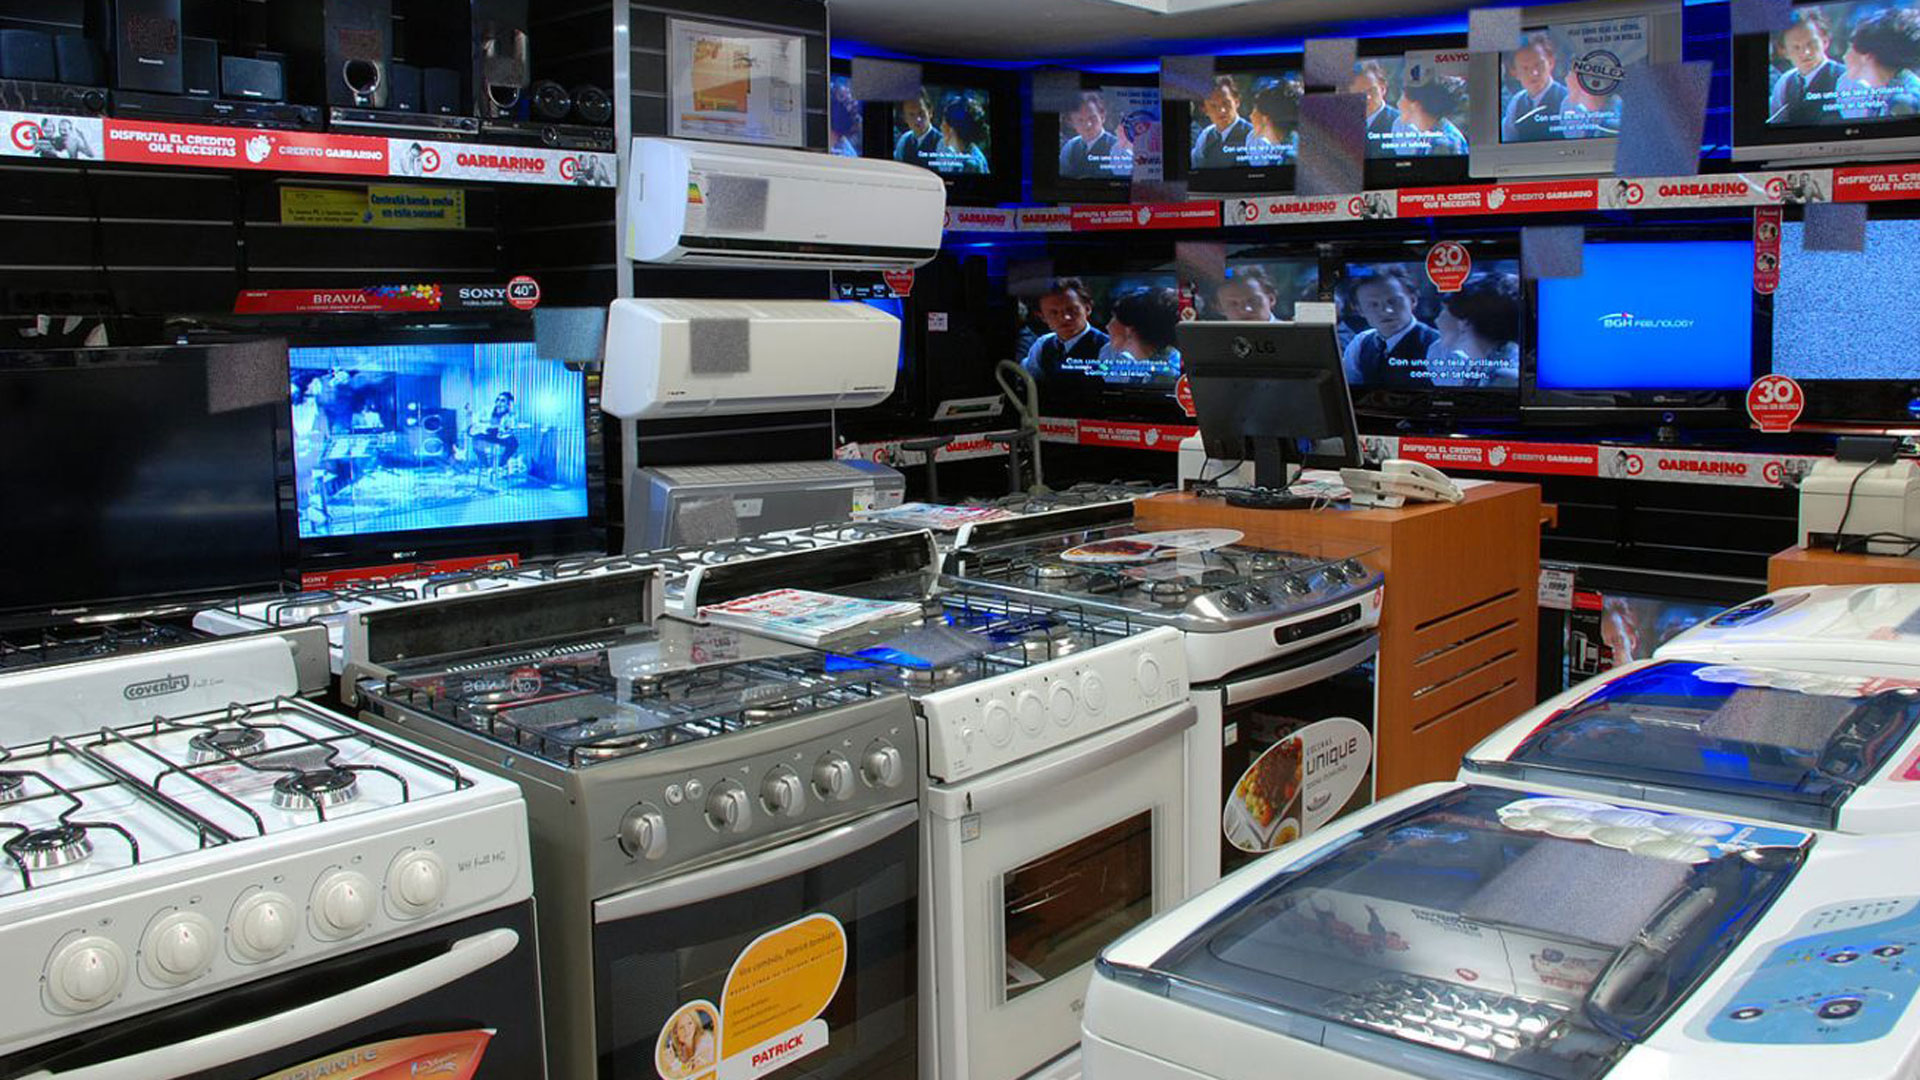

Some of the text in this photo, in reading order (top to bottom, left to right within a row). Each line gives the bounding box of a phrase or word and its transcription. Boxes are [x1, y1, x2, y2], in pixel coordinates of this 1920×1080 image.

[1434, 53, 1470, 63] SANYO
[1574, 61, 1626, 77] NOBLEX
[1806, 92, 1821, 100] Con
[1533, 113, 1548, 122] Con
[110, 129, 236, 147] DISFRUTA EL CREDITO
[148, 142, 236, 158] QUE NECESITAS
[278, 145, 383, 161] CREDITO GARBARINO
[457, 153, 545, 171] GARBARINO
[1838, 174, 1885, 185] DISFRUTA
[1888, 173, 1900, 182] EL
[1659, 181, 1748, 197] GARBARINO
[1869, 182, 1891, 191] QUE
[1400, 192, 1481, 203] DISFRUTA EL CREDITO
[1511, 190, 1593, 202] CREDITO GARBARINO
[1269, 200, 1337, 214] GARBARINO
[1423, 199, 1481, 209] QUE NECESITAS
[958, 213, 1006, 225] GARBARINO
[1180, 210, 1215, 218] GARBARINO
[1434, 246, 1463, 267] 30
[459, 288, 506, 298] SONY
[313, 294, 366, 304] BRAVIA
[1604, 318, 1633, 328] BGH
[1255, 341, 1276, 354] LG
[1066, 357, 1083, 365] Con
[1084, 358, 1101, 366] uno
[1388, 357, 1408, 367] Con
[1411, 359, 1430, 367] uno
[1432, 358, 1444, 367] de
[1448, 358, 1466, 367] tela
[1410, 370, 1438, 379] como
[1440, 370, 1450, 379] el
[1758, 381, 1793, 403] 30
[1403, 444, 1437, 453] DISFRUTA
[1449, 446, 1482, 455] CREDITO
[1425, 452, 1482, 463] QUE NECESITAS
[1512, 452, 1593, 464] CREDITO GARBARINO
[1658, 459, 1747, 475] GARBARINO
[302, 576, 328, 584] SONY
